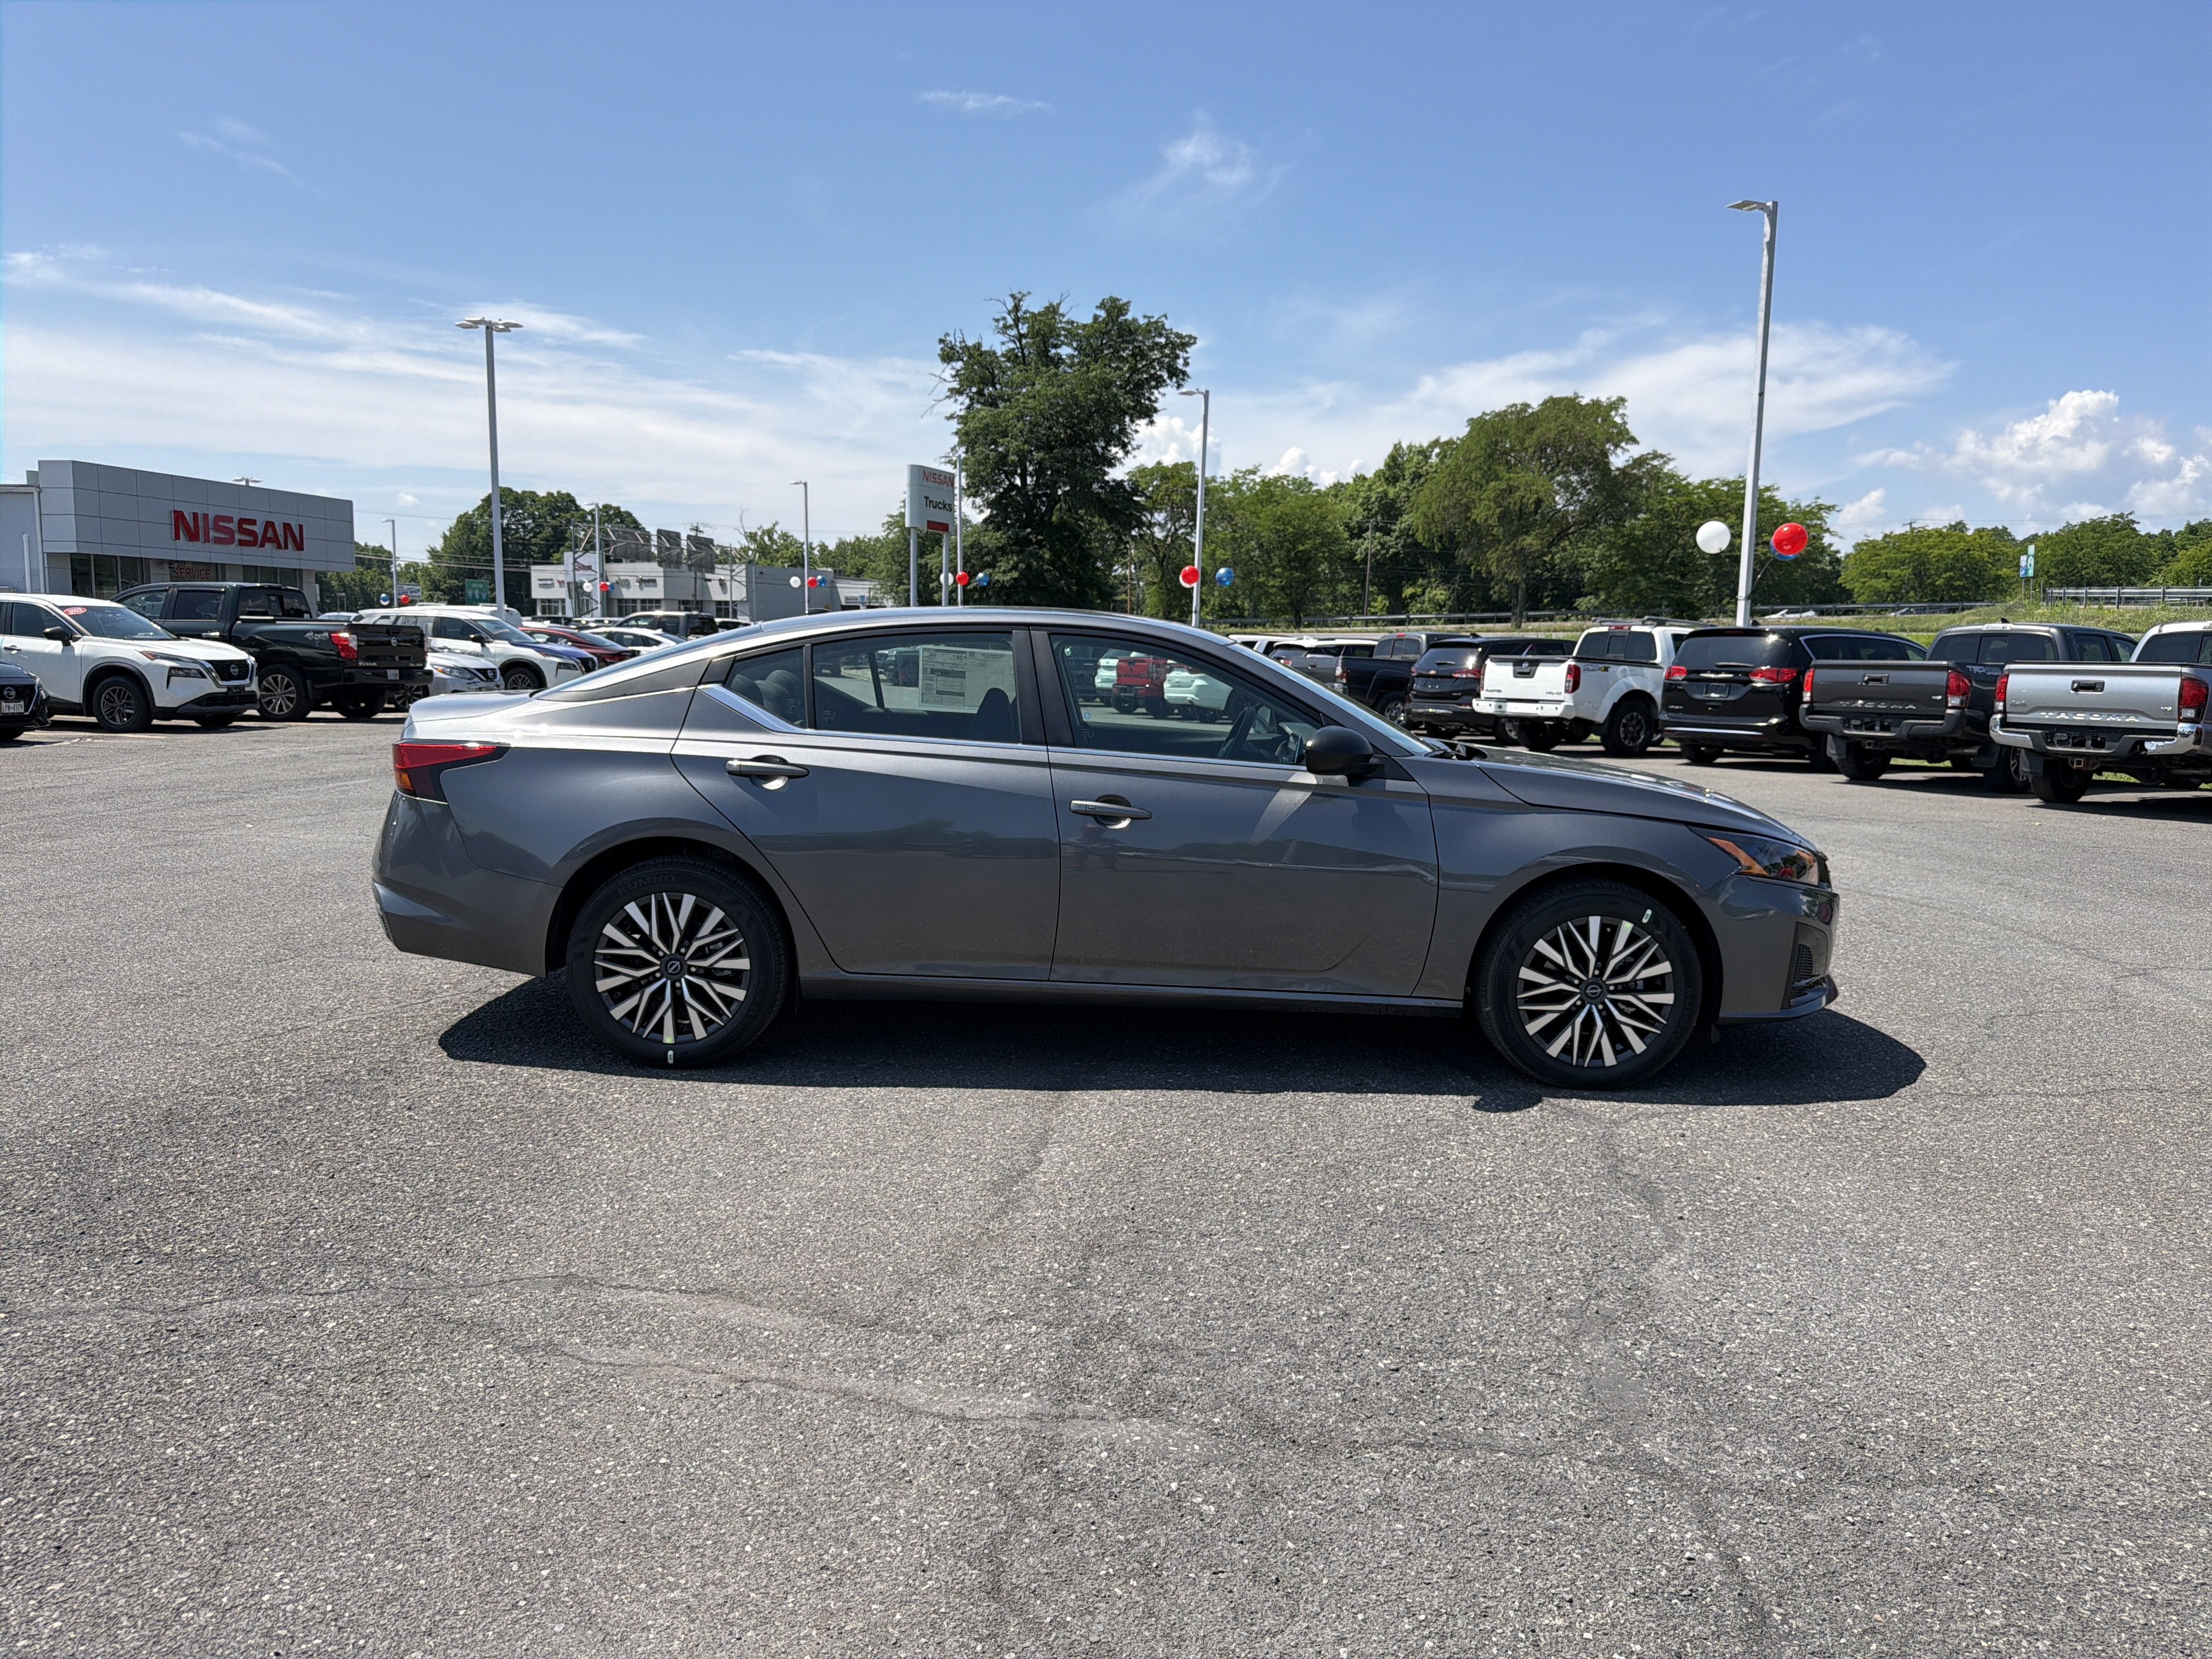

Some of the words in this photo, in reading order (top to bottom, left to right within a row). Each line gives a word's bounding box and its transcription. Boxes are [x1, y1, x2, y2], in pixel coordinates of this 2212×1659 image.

[923, 470, 955, 488] NISSAN
[924, 495, 952, 512] Trucks
[172, 510, 304, 551] NISSAN
[174, 567, 211, 580] SERVICE
[1966, 665, 1985, 674] TRD
[1839, 699, 1916, 709] TACOMA
[2040, 711, 2140, 722] TACOMA
